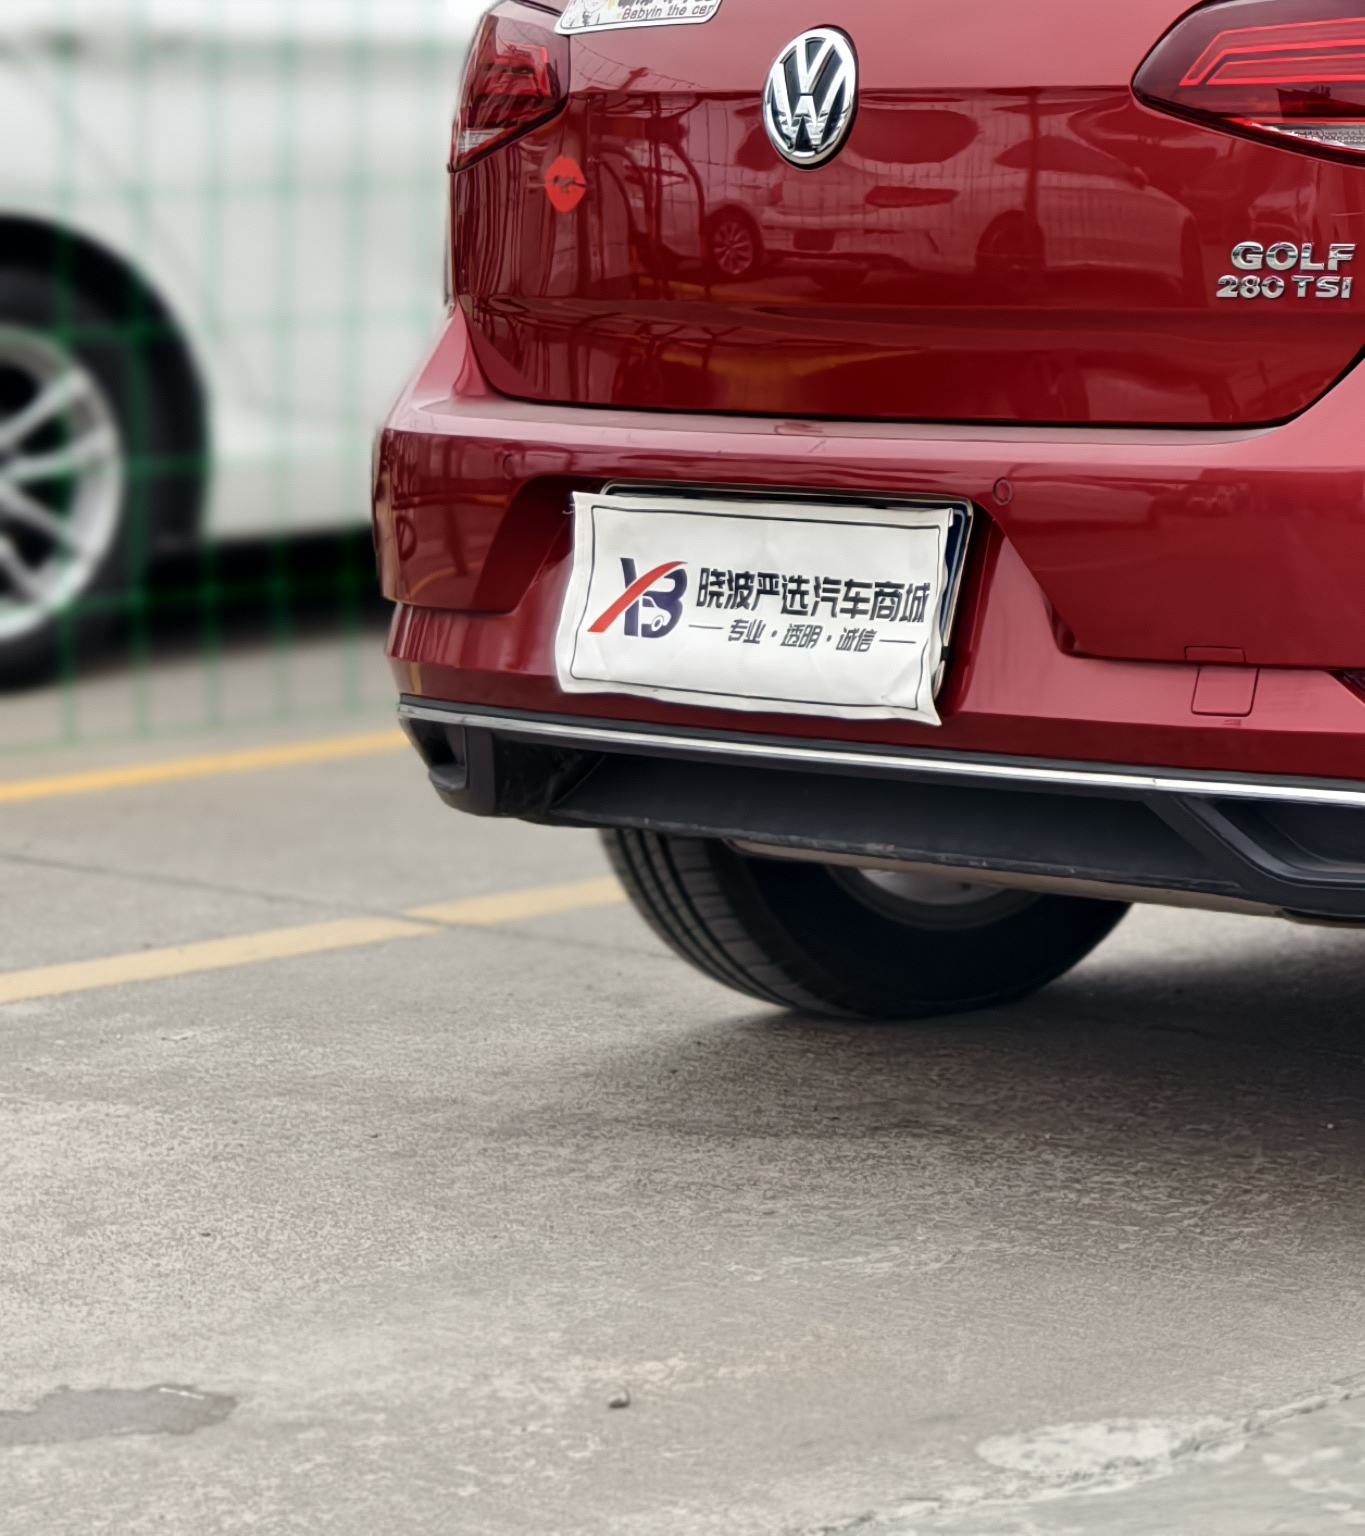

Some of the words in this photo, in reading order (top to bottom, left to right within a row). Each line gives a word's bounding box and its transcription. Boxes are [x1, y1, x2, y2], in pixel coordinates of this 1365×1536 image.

[667, 5, 688, 16] the
[692, 3, 715, 15] car
[1231, 241, 1357, 271] GOLF
[1216, 275, 1285, 299] 280
[1291, 275, 1353, 299] TSI
[696, 567, 931, 624] 晓波严选汽车商城
